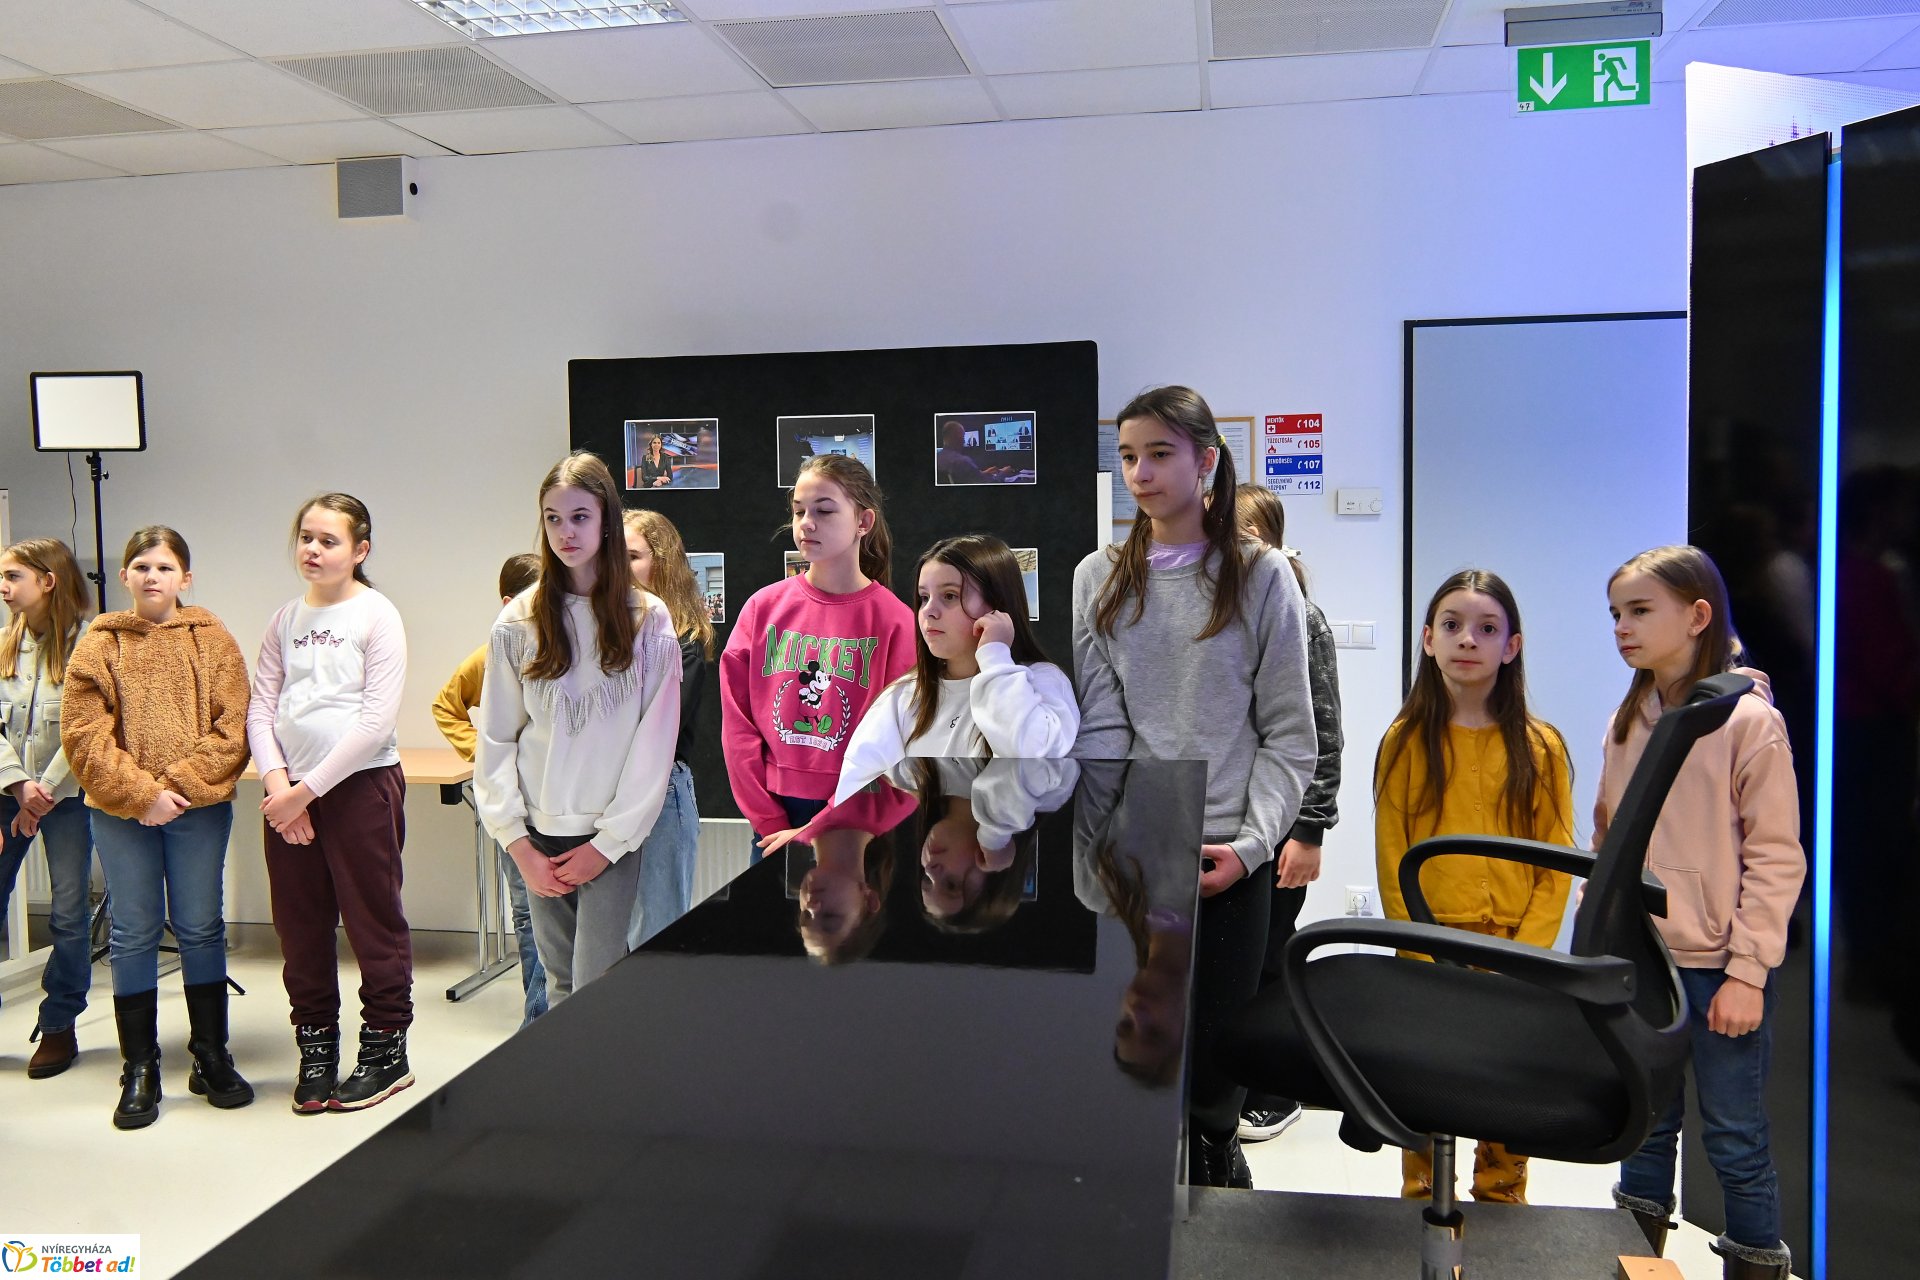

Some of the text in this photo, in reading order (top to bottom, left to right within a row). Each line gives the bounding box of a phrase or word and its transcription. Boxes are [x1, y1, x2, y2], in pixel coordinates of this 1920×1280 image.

[1303, 419, 1320, 428] 104
[1303, 439, 1320, 448] 105
[1304, 460, 1320, 469] 107
[1304, 481, 1321, 490] 112
[762, 624, 878, 689] MICKEY
